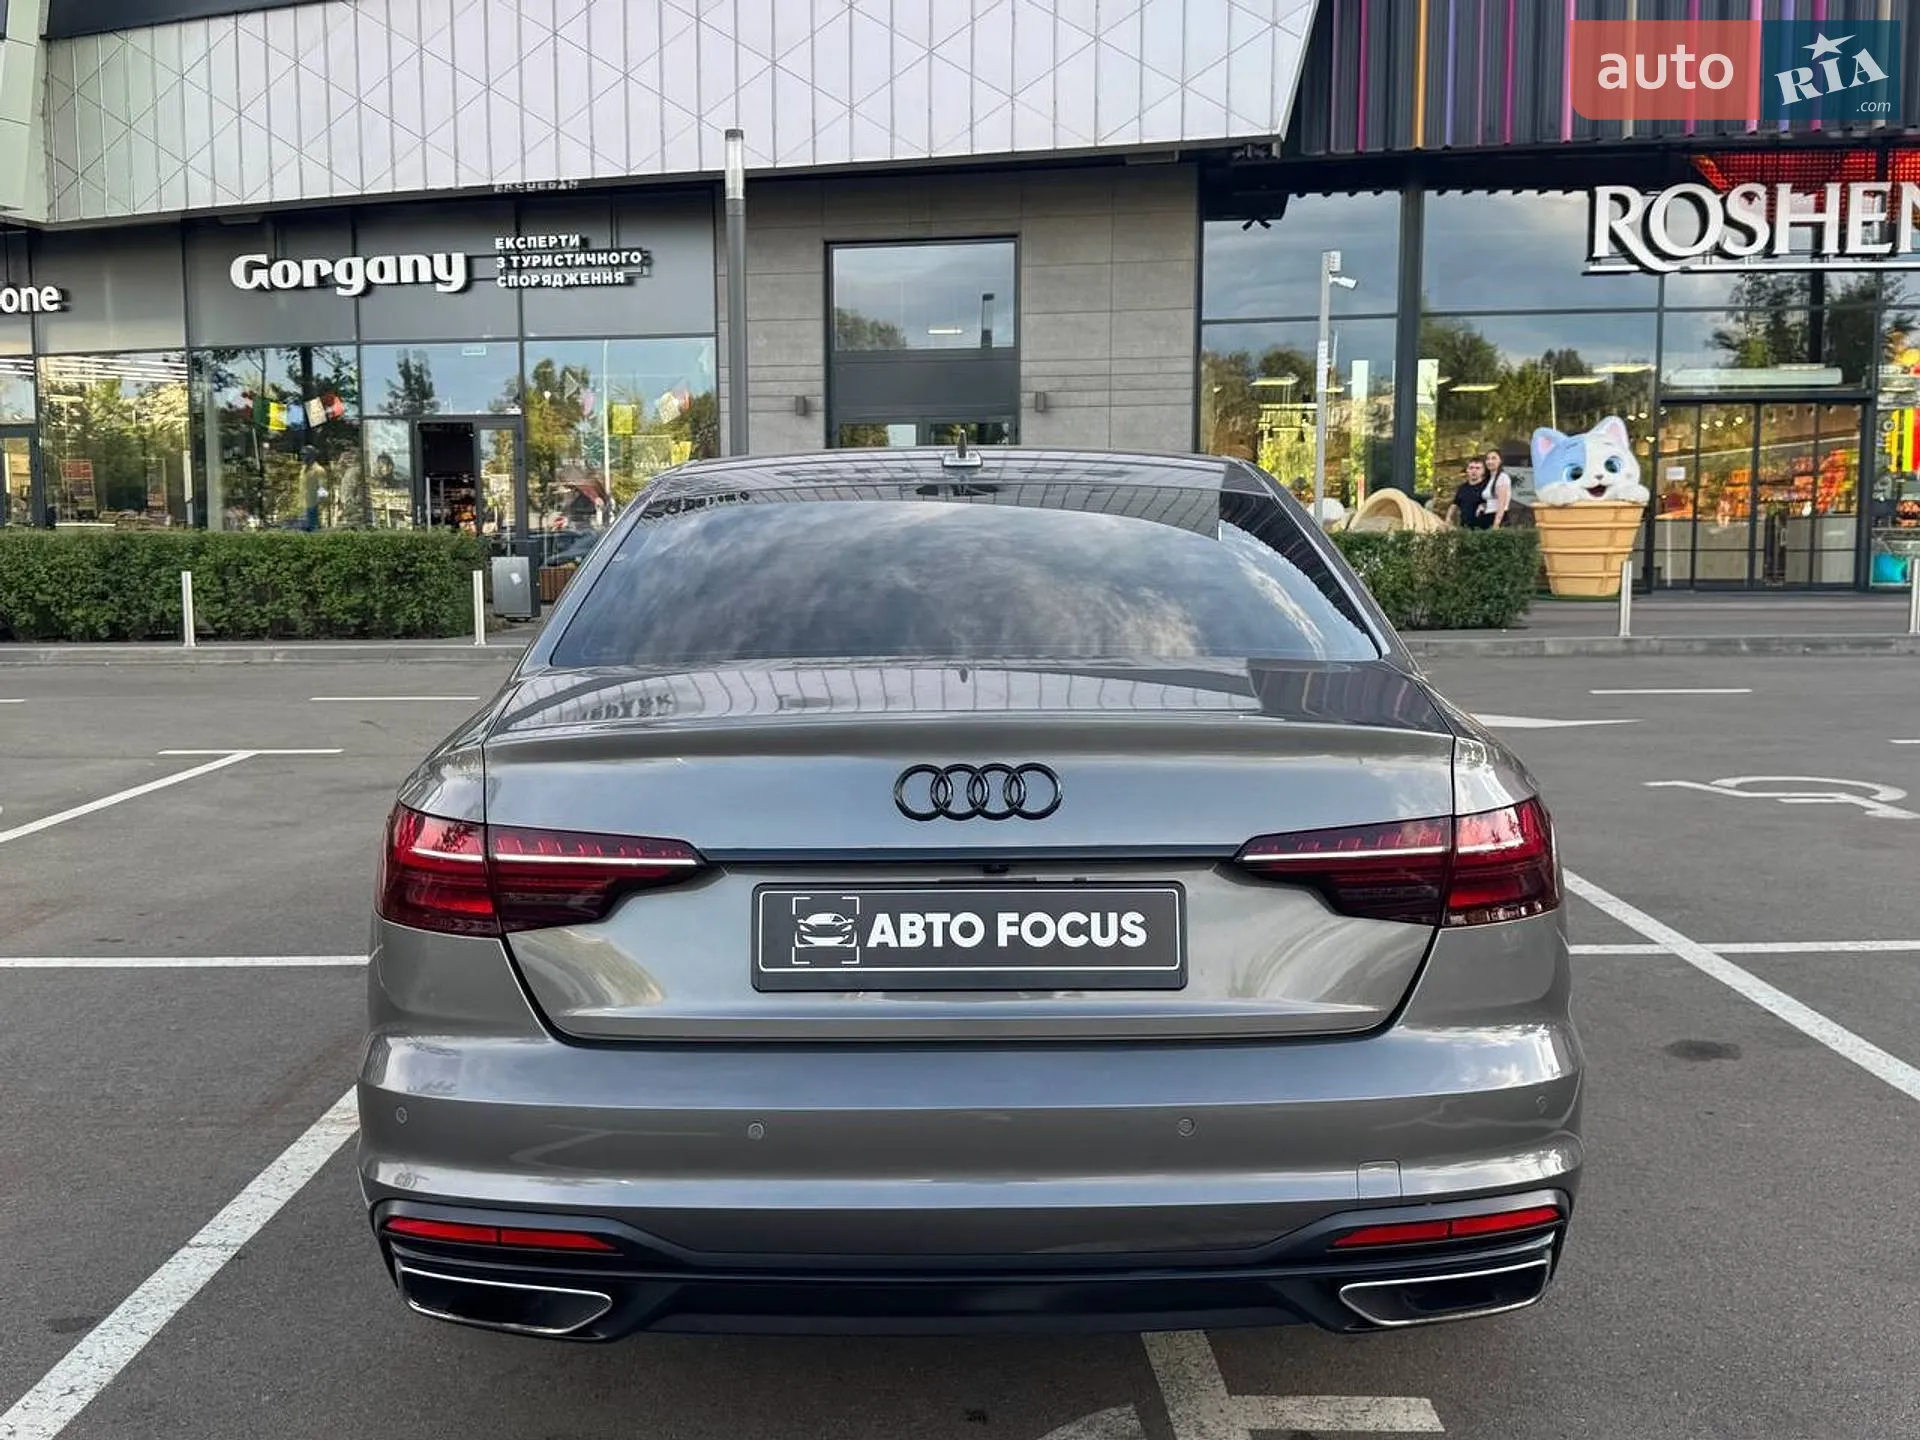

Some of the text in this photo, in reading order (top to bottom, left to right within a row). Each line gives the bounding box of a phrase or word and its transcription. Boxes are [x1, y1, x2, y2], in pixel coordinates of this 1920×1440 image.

[494, 234, 580, 250] ЕКСПЕРТИ
[496, 251, 642, 269] З ТУРИСТИЧНОГО
[230, 252, 467, 297] Gorgany
[496, 271, 625, 288] СПОРЯДЖЕННЯ
[0, 285, 62, 313] one
[866, 911, 1147, 948] АВТО FOCUS
